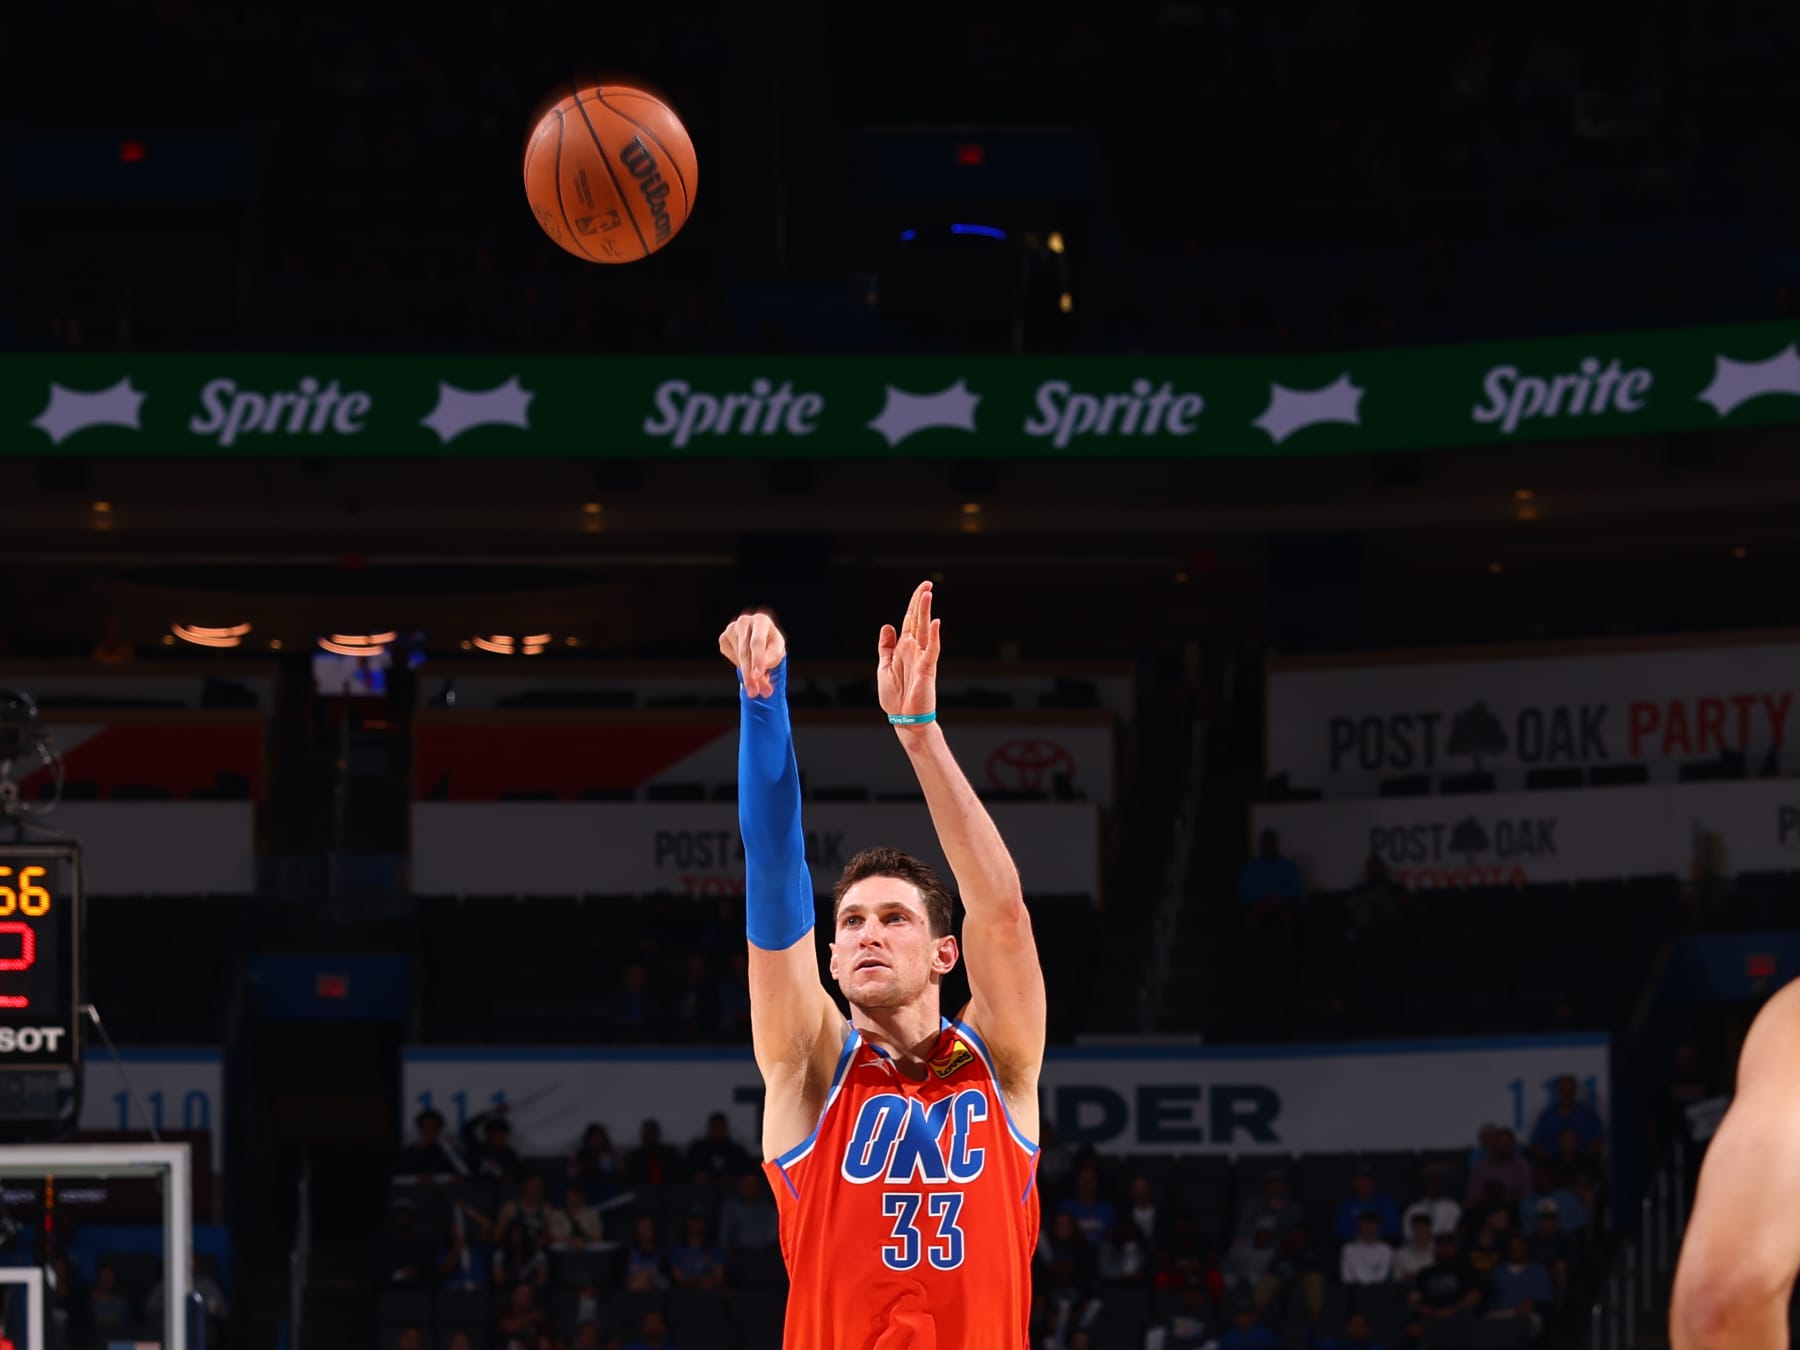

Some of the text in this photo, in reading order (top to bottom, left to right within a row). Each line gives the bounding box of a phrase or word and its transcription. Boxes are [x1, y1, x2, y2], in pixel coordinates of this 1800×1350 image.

[620, 136, 673, 244] Wilson
[190, 376, 371, 447] Sprite
[643, 378, 825, 449] Sprite
[1023, 378, 1206, 449] Sprite
[1471, 357, 1655, 433] Sprite
[1330, 692, 1793, 772] POST OAK PARTY
[655, 831, 732, 868] POST
[1369, 817, 1558, 862] POST OAK
[111, 1090, 209, 1132] 110
[840, 1088, 988, 1185] OKC
[882, 1192, 965, 1271] 33
